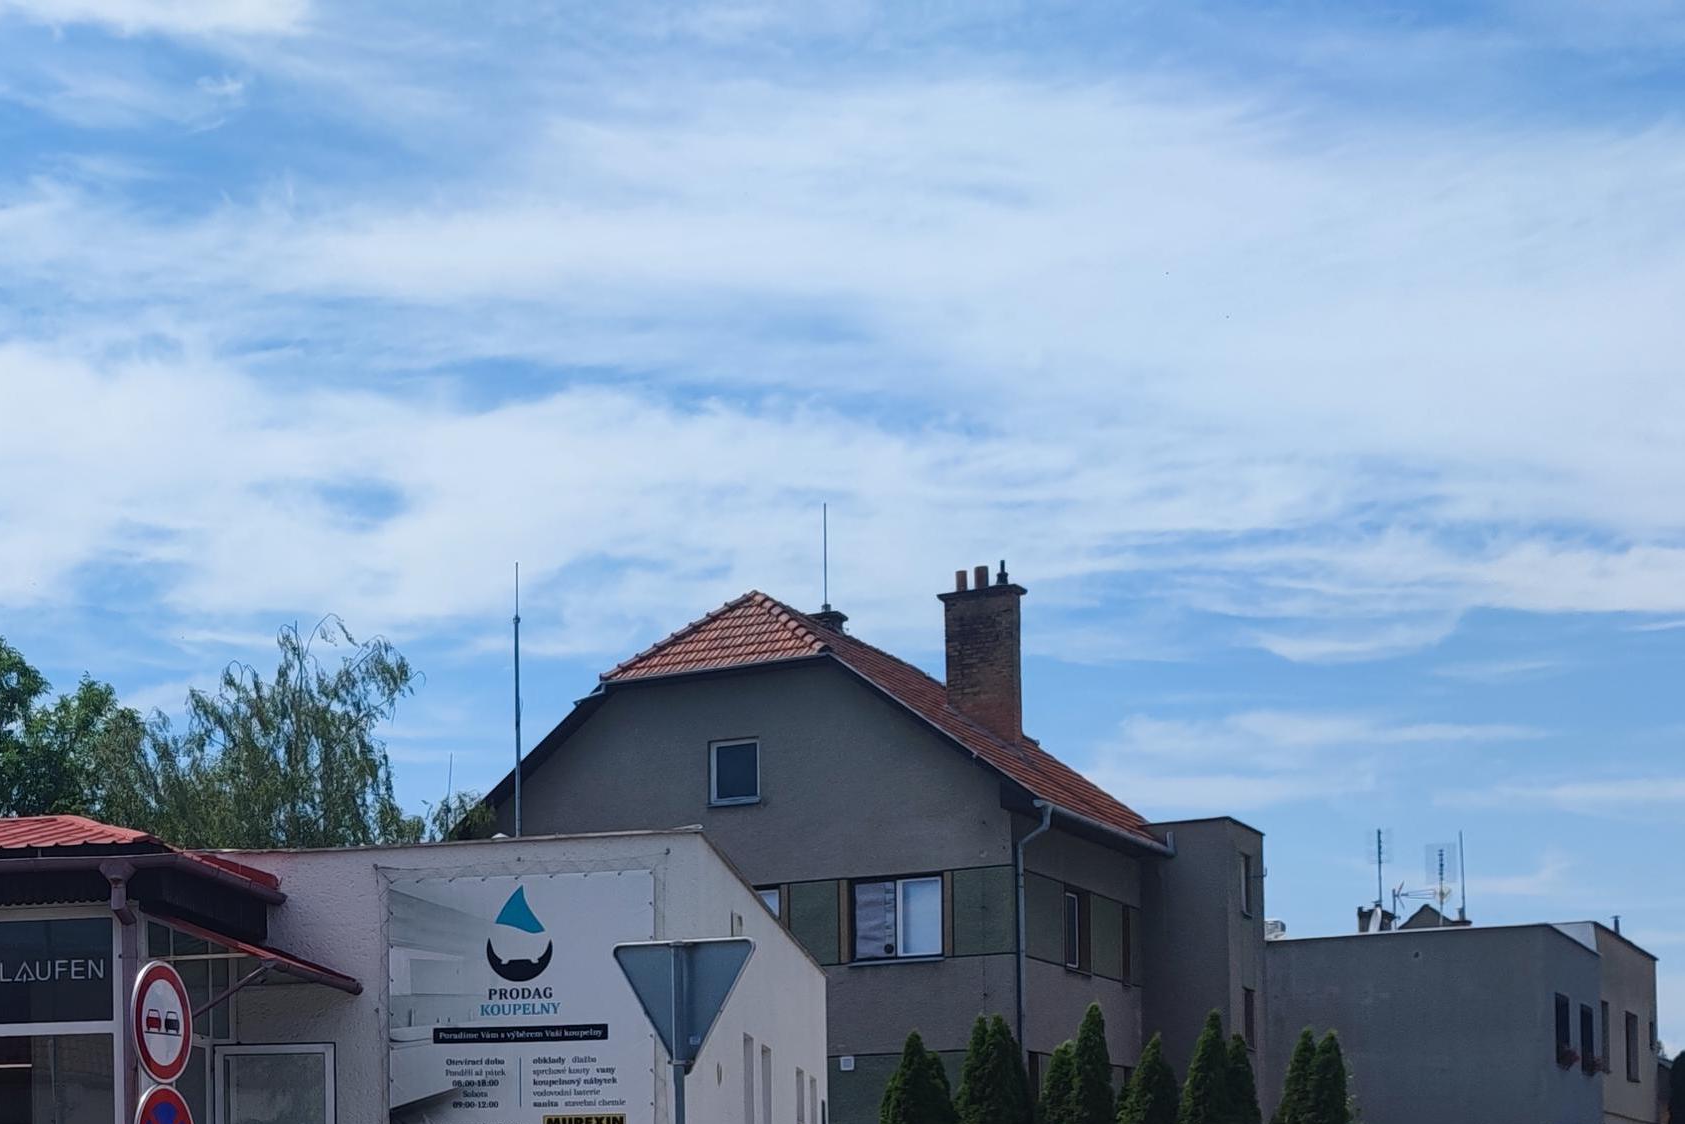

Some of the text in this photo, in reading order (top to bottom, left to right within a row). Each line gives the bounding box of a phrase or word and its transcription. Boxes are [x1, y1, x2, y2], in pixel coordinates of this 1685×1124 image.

[0, 959, 104, 983] LAUFEN
[488, 987, 553, 1001] PRODAG
[480, 1002, 561, 1017] KOUPELNY
[564, 1028, 603, 1039] koupelny
[533, 1056, 566, 1066] obklady
